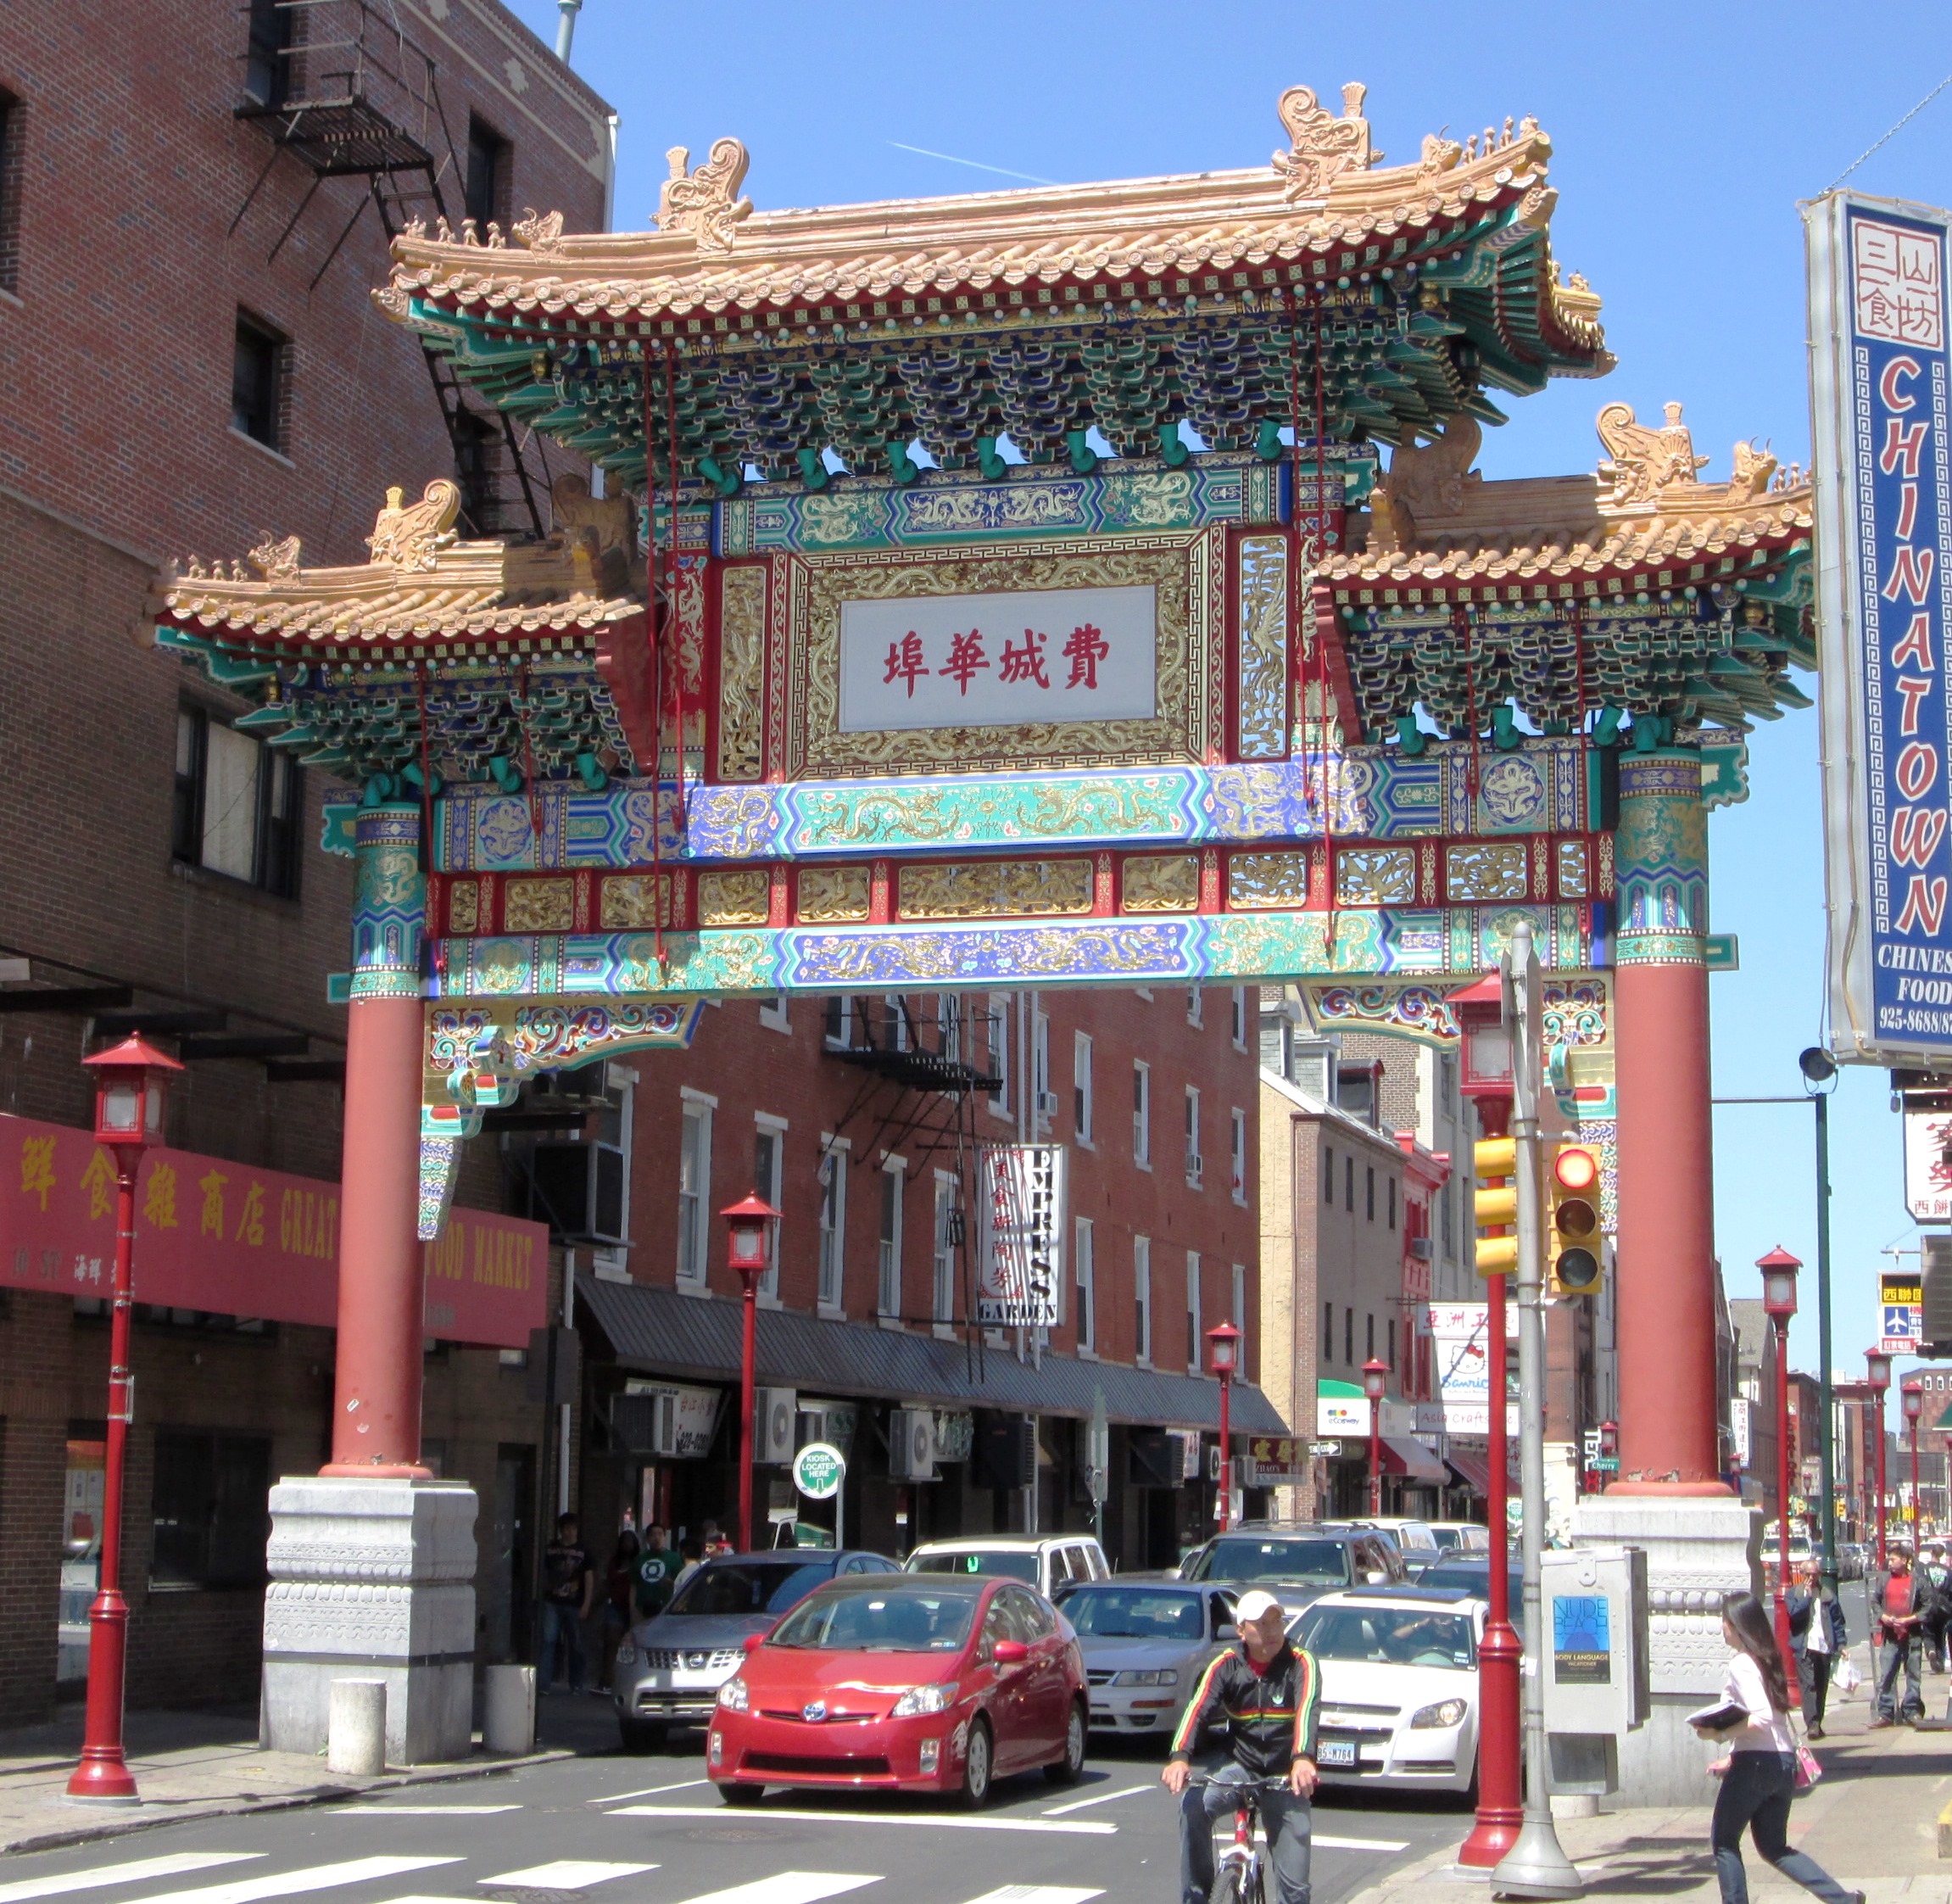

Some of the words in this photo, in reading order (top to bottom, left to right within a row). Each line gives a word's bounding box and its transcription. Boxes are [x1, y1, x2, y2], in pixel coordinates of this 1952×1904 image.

[1897, 977, 1952, 1005] FOOD
[1030, 1150, 1054, 1299] EMPRESS
[281, 1187, 337, 1259] GREAT
[473, 1226, 533, 1290] MARKET
[980, 1304, 1057, 1320] GARDEN
[1421, 1411, 1447, 1425] Asia
[1452, 1411, 1489, 1427] Crafts
[801, 1462, 836, 1471] LOCATED
[1592, 1461, 1615, 1470] Cherry
[1553, 1599, 1607, 1618] NUDE
